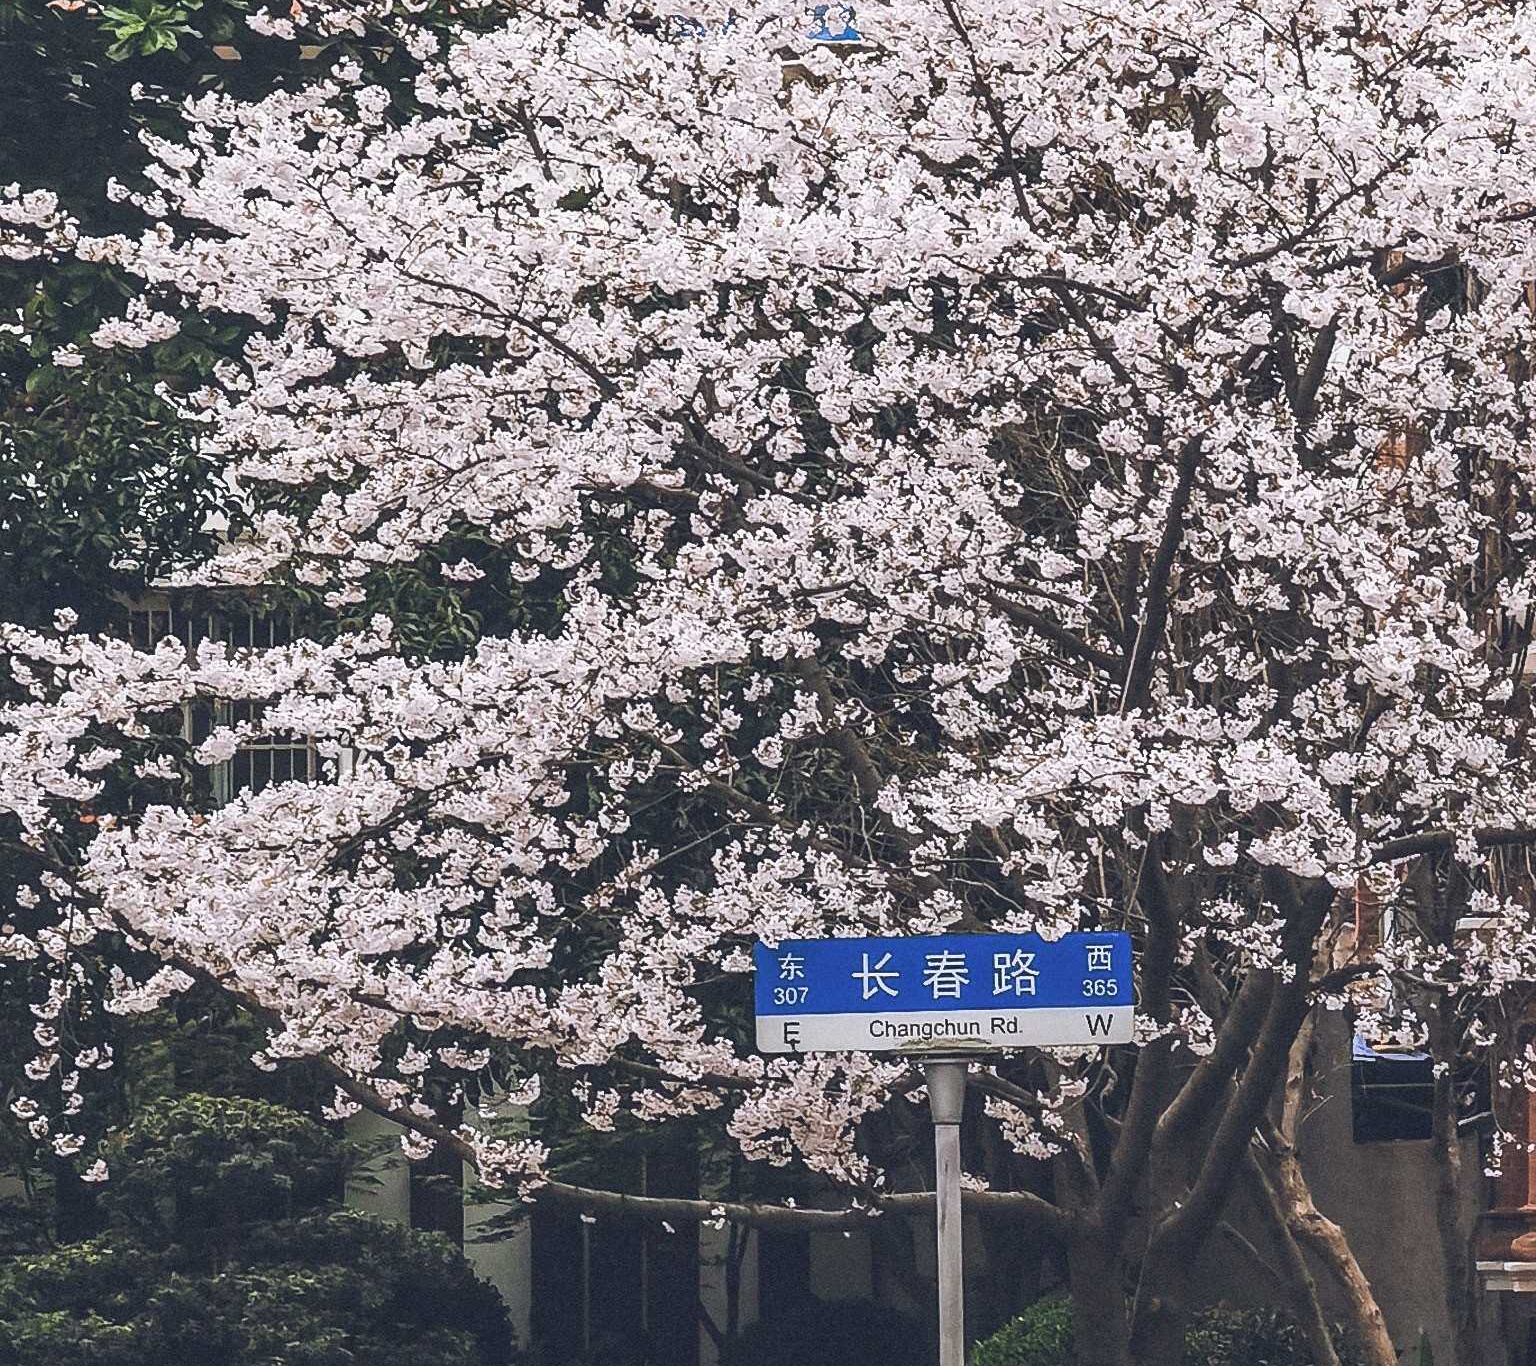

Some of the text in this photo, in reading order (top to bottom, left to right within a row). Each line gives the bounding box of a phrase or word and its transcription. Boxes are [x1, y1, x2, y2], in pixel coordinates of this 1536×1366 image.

[778, 953, 805, 980] 东
[1086, 944, 1114, 972] 西
[851, 948, 1041, 1000] 长春路
[773, 987, 809, 1005] 307
[1081, 978, 1118, 997] 365
[784, 1022, 800, 1044] E
[869, 1016, 1023, 1041] Changchun Rd.
[1086, 1014, 1114, 1036] W
